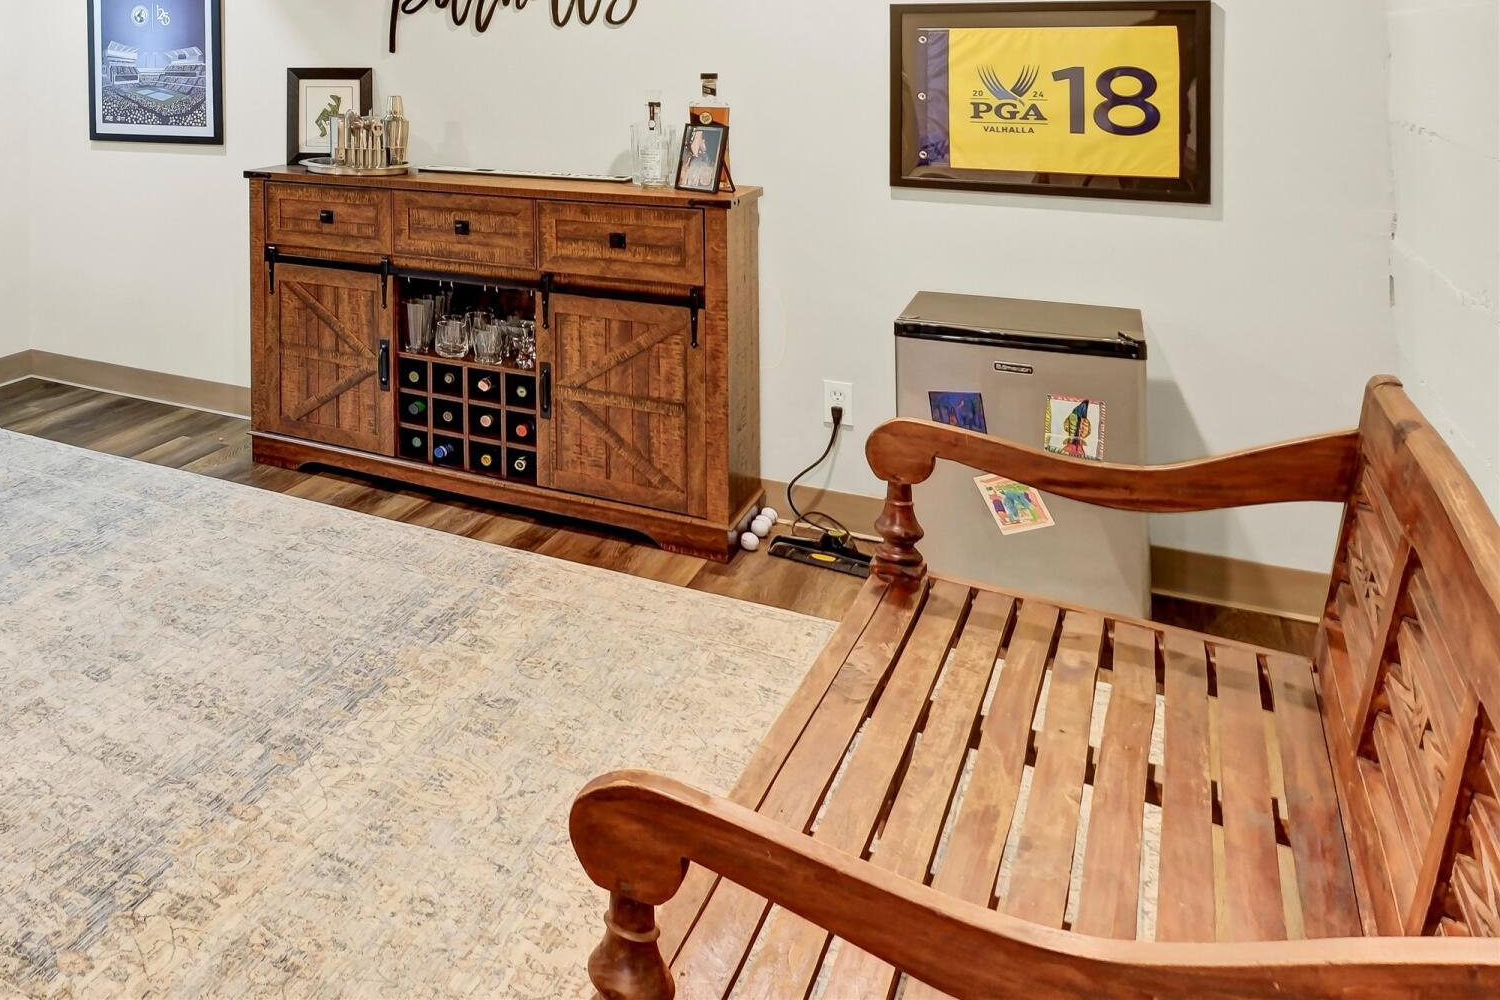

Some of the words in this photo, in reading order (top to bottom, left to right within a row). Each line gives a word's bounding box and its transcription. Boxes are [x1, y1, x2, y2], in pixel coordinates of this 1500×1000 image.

[972, 89, 984, 97] 20
[1051, 65, 1161, 136] 18
[969, 101, 1048, 121] PGA
[983, 125, 1035, 134] VALHALLA
